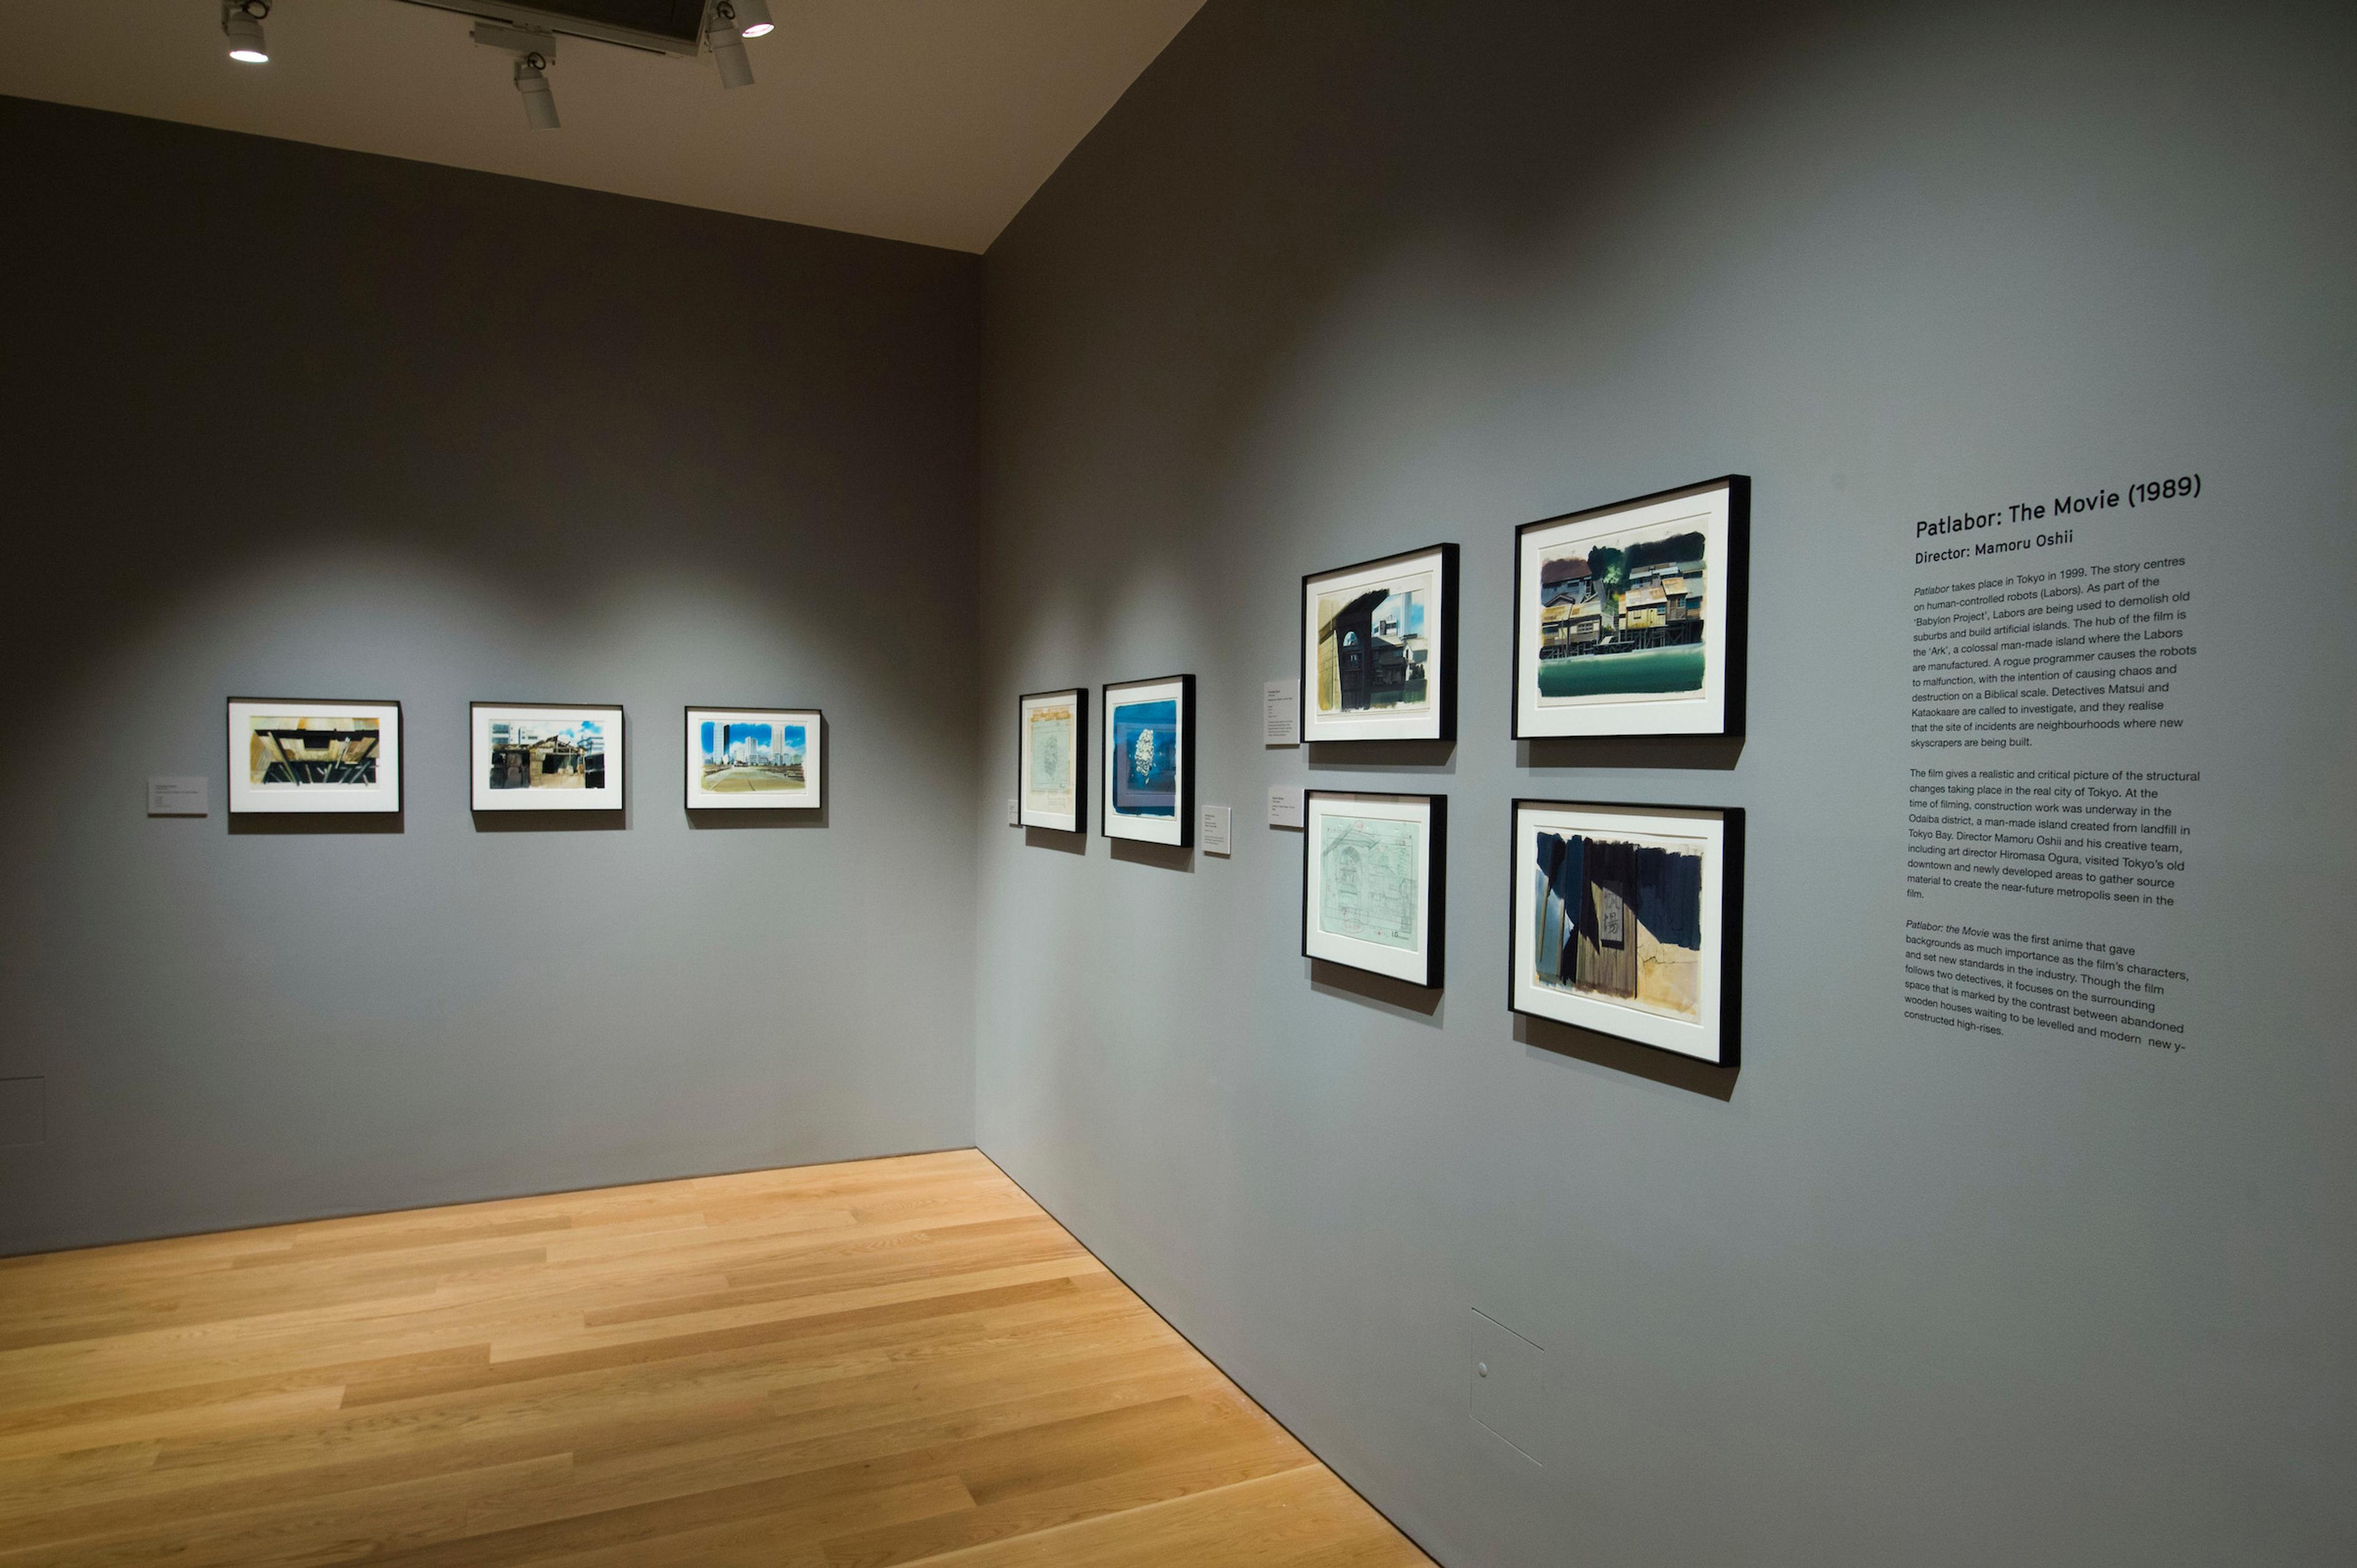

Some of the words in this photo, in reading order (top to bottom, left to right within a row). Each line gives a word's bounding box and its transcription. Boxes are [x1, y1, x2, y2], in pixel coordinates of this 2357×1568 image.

[1916, 512, 2002, 538] Patlabor:
[2011, 503, 2046, 523] The
[2054, 489, 2120, 516] Movie
[2128, 473, 2201, 508] (1989)
[1915, 548, 1970, 565] Director:
[1975, 539, 2031, 556] Mamoru
[2036, 529, 2073, 547] Oshii
[1913, 585, 1950, 597] Patlabor
[1951, 582, 1976, 592] takes
[1977, 579, 2003, 591] place
[2005, 576, 2014, 585] in
[2016, 574, 2045, 585] Tokyo
[2047, 571, 2057, 581] in
[2059, 567, 2088, 579] 1999.
[2091, 565, 2111, 575] The
[2113, 563, 2141, 573] story
[2143, 557, 2186, 570] centres
[1926, 593, 2005, 610] human-controlled
[2007, 590, 2038, 601] robots
[2040, 585, 2084, 600] (Labors).
[2086, 583, 2101, 593] As
[2103, 581, 2125, 593] part
[2127, 577, 2139, 589] of
[2142, 577, 2160, 587] the
[1992, 609, 2026, 619] Labors
[2027, 607, 2043, 616] are
[2045, 603, 2074, 614] being
[2076, 600, 2102, 611] used
[2104, 599, 2116, 608] to
[2118, 593, 2169, 607] demolish
[2171, 591, 2191, 602] old
[1913, 631, 1948, 642] suburbs
[1949, 628, 1967, 639] and
[1968, 627, 1991, 637] build
[1993, 623, 2030, 635] artificial
[2032, 620, 2070, 631] islands.
[2074, 618, 2093, 628] The
[2095, 616, 2116, 626] hub
[2118, 613, 2130, 624] of
[2132, 613, 2151, 624] the
[2153, 611, 2173, 621] film
[2177, 609, 2187, 620] is
[1912, 648, 1927, 657] the
[1960, 641, 1999, 653] colossal
[2000, 638, 2053, 650] man-made
[2055, 635, 2086, 646] island
[2088, 634, 2121, 644] where
[2123, 631, 2141, 641] the
[2143, 629, 2183, 640] Labors
[1910, 768, 1926, 778] The
[1927, 768, 1944, 778] film
[1945, 769, 1969, 779] gives
[1978, 770, 2014, 779] realistic
[2016, 770, 2035, 779] and
[2037, 770, 2070, 779] critical
[2072, 770, 2109, 781] picture
[2111, 770, 2123, 780] of
[2125, 770, 2143, 781] the
[2145, 771, 2200, 781] structural
[1908, 798, 1928, 808] time
[1929, 799, 1938, 808] of
[1940, 799, 1972, 811] filming,
[1973, 801, 2032, 811] construction
[2034, 803, 2059, 813] work
[2061, 805, 2083, 814] was
[2085, 805, 2138, 817] underway
[2140, 806, 2151, 816] in
[2153, 806, 2172, 817] the
[1909, 784, 1946, 795] changes
[1947, 784, 1975, 796] taking
[1976, 785, 2002, 795] place
[2004, 786, 2013, 795] in
[2015, 786, 2031, 795] the
[2033, 786, 2052, 795] real
[2053, 786, 2072, 798] city
[2074, 787, 2085, 797] of
[2088, 787, 2122, 800] Tokyo.
[2124, 788, 2137, 798] At
[2140, 788, 2159, 798] the
[1908, 813, 1940, 824] Odaiba
[1941, 815, 1974, 826] district,
[1984, 819, 2036, 828] man-made
[2038, 819, 2068, 830] island
[2070, 822, 2110, 832] created
[2112, 822, 2138, 833] from
[2140, 823, 2177, 835] landfill
[2180, 825, 2191, 835] in
[1908, 828, 1933, 840] Tokyo
[1935, 830, 1954, 841] Bay.
[1956, 831, 1992, 841] Director
[1994, 833, 2034, 844] Mamoru
[2036, 835, 2062, 846] Oshii
[2064, 838, 2084, 848] and
[2086, 838, 2102, 848] his
[2104, 840, 2148, 851] creative
[2150, 842, 2183, 854] team,
[1906, 888, 1924, 898] film.
[1905, 919, 1944, 932] Patlabor:
[1945, 924, 1960, 934] the
[1961, 926, 1990, 938] Movie
[1991, 932, 2011, 941] was
[2013, 932, 2029, 943] the
[2030, 933, 2050, 945] first
[2051, 938, 2083, 949] anime
[2085, 941, 2107, 952] that
[2108, 945, 2135, 956] gave
[1905, 934, 1962, 950] backgrounds
[1962, 943, 1975, 952] as
[1976, 945, 2003, 955] much
[2004, 947, 2060, 963] importance
[2061, 957, 2075, 965] as
[2076, 957, 2094, 968] the
[2126, 964, 2189, 982] characters,
[1905, 951, 1922, 959] and
[1938, 956, 1957, 965] new
[1959, 958, 2005, 971] standards
[2006, 964, 2016, 973] in
[2017, 965, 2034, 976] the
[2035, 967, 2078, 984] industry.
[2080, 973, 2121, 990] Though
[2123, 980, 2142, 992] the
[2144, 983, 2164, 995] film
[1905, 964, 1935, 977] follows
[1936, 970, 1953, 979] two
[1954, 972, 2004, 989] detectives,
[2007, 979, 2013, 989] it
[2015, 981, 2054, 995] focuses
[2056, 989, 2069, 998] on
[2071, 990, 2088, 1001] the
[2091, 994, 2156, 1013] surrounding
[1903, 1011, 1955, 1026] constructed
[1956, 1018, 2004, 1036] high-rises.
[1904, 981, 1930, 992] space
[1932, 984, 1949, 995] that
[1951, 986, 1959, 996] is
[1960, 990, 1995, 1002] marked
[1997, 994, 2010, 1006] by
[2011, 997, 2027, 1008] the
[2029, 1001, 2070, 1014] contrast
[2073, 1006, 2118, 1022] between
[2120, 1015, 2185, 1033] abandoned
